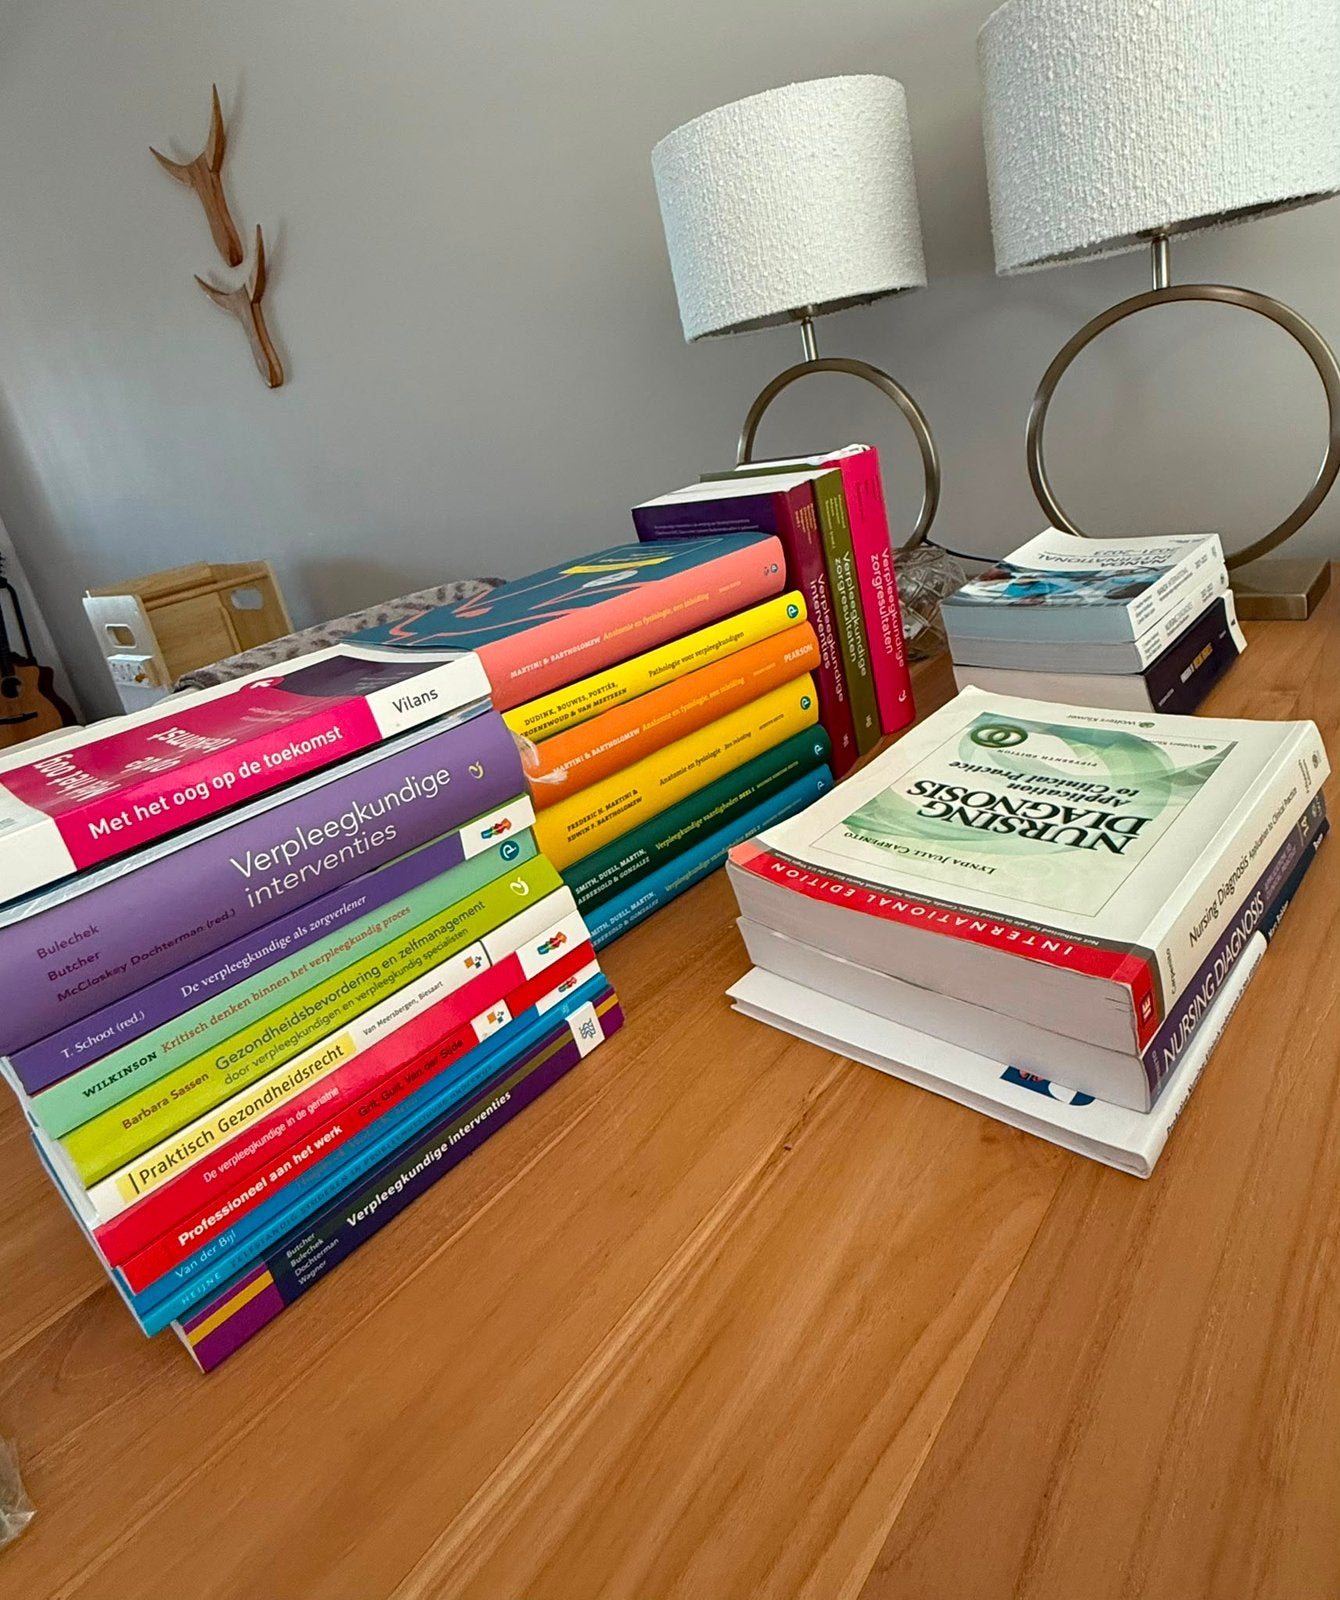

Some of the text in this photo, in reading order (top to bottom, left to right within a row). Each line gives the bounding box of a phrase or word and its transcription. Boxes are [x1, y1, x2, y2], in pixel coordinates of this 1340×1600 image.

[834, 558, 857, 663] zorgresultaten
[843, 551, 867, 677] Verpleegkundige
[871, 554, 893, 655] zorgresultaten
[882, 548, 905, 668] Verpleegkundige
[510, 636, 601, 679] MARTINI & BARTHOLOMEW
[648, 631, 745, 678] Pathologie voor verpleegkundigen
[784, 643, 814, 663] PEARSON
[817, 573, 844, 703] Verpleegkundige
[392, 688, 439, 713] Vilans
[524, 695, 589, 726] DUDINK, BOUWES,
[570, 710, 577, 718] &
[578, 703, 592, 713] VAN
[33, 753, 74, 776] oog
[584, 752, 591, 760] &
[592, 728, 641, 757] BARTHOLOMEW
[996, 748, 1035, 759] EDITION
[88, 725, 343, 840] Met het oog op de toekomst
[659, 766, 687, 786] Anatomie
[948, 760, 1140, 797] to Clinical Practice
[1006, 783, 1132, 807] Application
[229, 769, 450, 878] Verpleegkundige
[566, 810, 598, 832] FREDERIC
[605, 793, 632, 811] MARTINI
[567, 796, 643, 843] EDWIN BARTHOLOMEW
[907, 780, 1152, 836] DIAGNOSIS
[917, 800, 1138, 855] NURSING
[655, 819, 703, 851] Verpleegkundige
[844, 832, 997, 875] LYNDA JUALL CARPENITO
[244, 824, 397, 908] interventies
[575, 848, 647, 895] SMITH, DUELL, MARTIN,
[578, 856, 650, 905] AEBERSOLD & GONZALEZ
[590, 891, 657, 937] MITH, DUELL, MARTIN,
[770, 862, 1073, 955] INTERNATIONAL EDITION
[981, 912, 1005, 922] United
[1188, 855, 1249, 947] Nursing Diagnosis
[36, 923, 100, 960] Bulechek
[57, 908, 236, 1002] McCloskey Dochterman (red.)
[180, 894, 367, 998] De verpleegkundige als zorgverlener
[593, 922, 624, 946] EBERSOLD
[1082, 938, 1100, 947] Not
[47, 951, 100, 982] Butcher
[160, 905, 411, 1053] Kritisch denken binnen het verpleegkundig proces
[215, 900, 486, 1071] Gezondheidsbevordering en zelfmanagement
[1163, 974, 1216, 1073] NURSING
[1214, 891, 1264, 987] DIAGNOSIS
[224, 928, 468, 1085] door verpleegkundigen en verpleegkundig specialisten
[363, 981, 443, 1036] Van Meersbergen, Biesaart
[60, 1010, 146, 1059] T. Schoot (red.)
[82, 1051, 157, 1098] WILKINSON
[404, 1070, 423, 1084] Van
[423, 1058, 439, 1070] der
[122, 1072, 209, 1131] Barbara Sassen
[139, 1129, 215, 1185] Praktisch
[218, 1044, 345, 1134] Gezondheidsrecht
[202, 1169, 218, 1183] De
[218, 1123, 287, 1173] verpleegkundige
[287, 1115, 295, 1127] in
[295, 1108, 307, 1121] de
[347, 1143, 449, 1228] Verpleegkundige
[448, 1090, 512, 1146] interventies
[178, 1124, 344, 1247] Professioneel aan het werk
[175, 1230, 237, 1279] Van der Bijl
[285, 1232, 316, 1258] Butcher
[290, 1238, 324, 1268] Bulechek
[294, 1238, 340, 1277] Dochterman
[298, 1260, 327, 1286] Wagner
